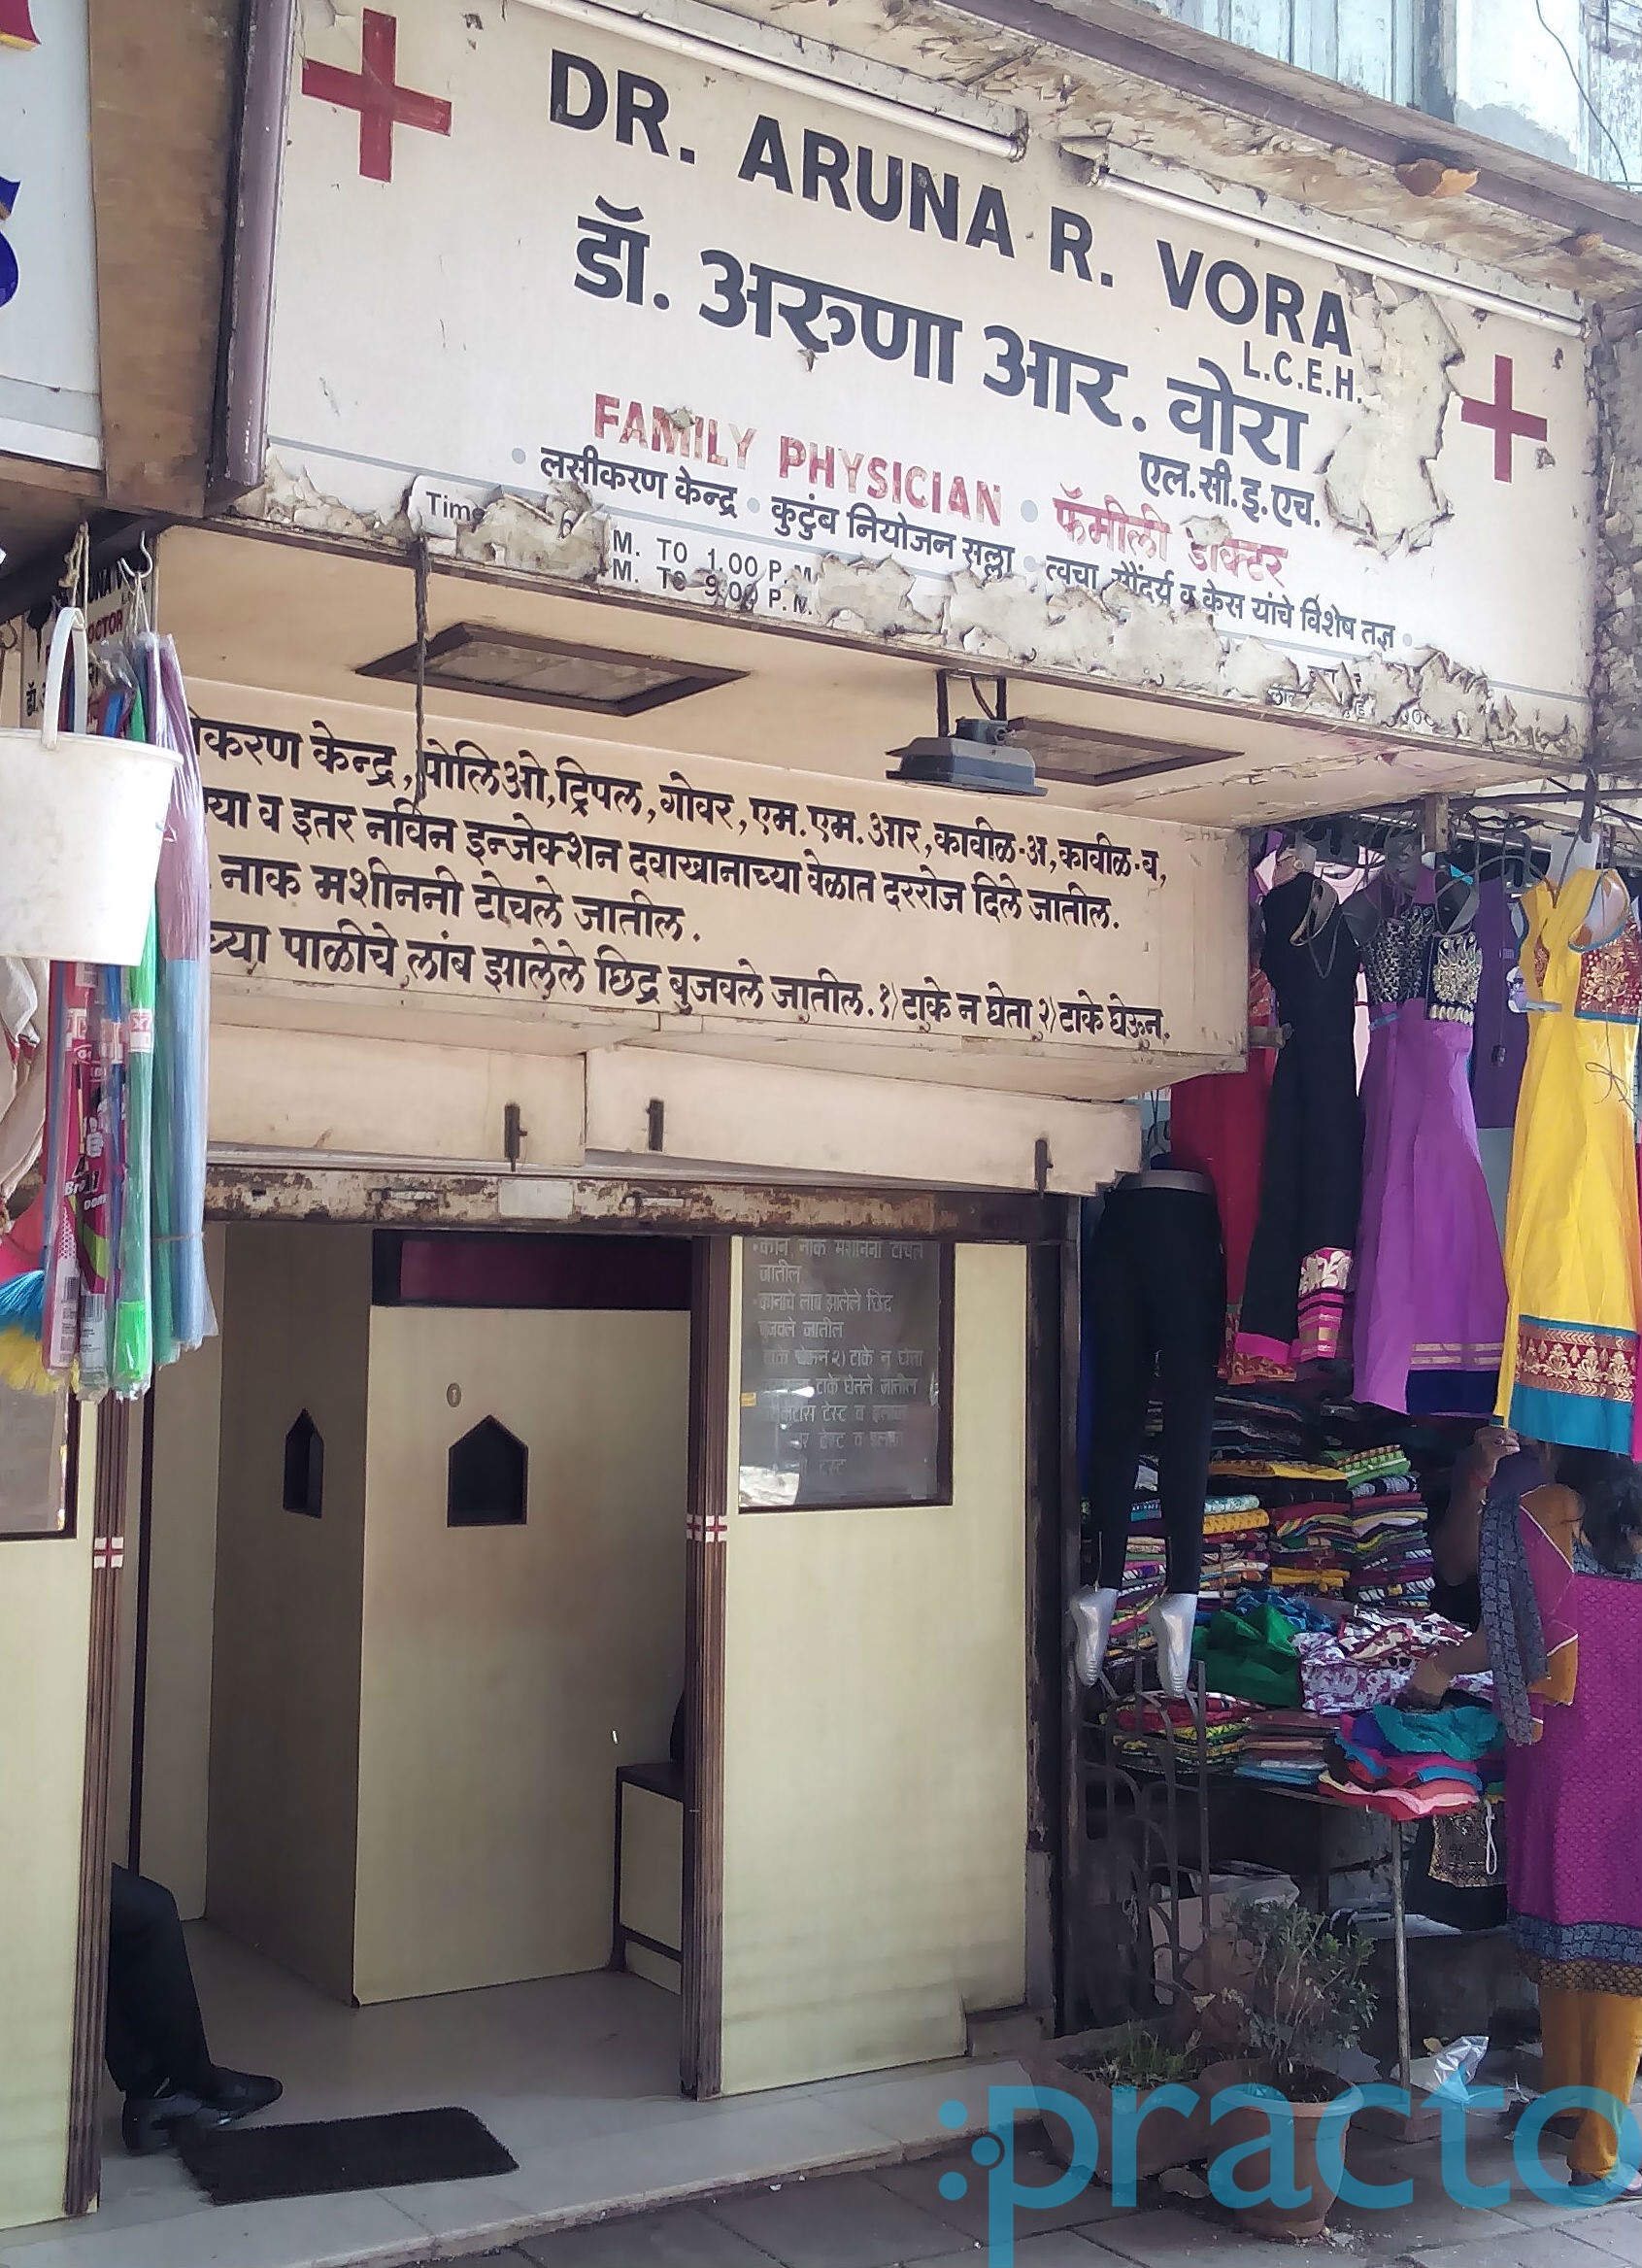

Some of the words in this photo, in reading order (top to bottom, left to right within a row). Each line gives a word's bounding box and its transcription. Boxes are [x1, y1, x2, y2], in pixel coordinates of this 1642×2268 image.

[550, 49, 695, 165] DR.
[737, 114, 1015, 259] ARUNA
[1050, 206, 1113, 288] R.
[1156, 240, 1352, 356] VORA
[574, 194, 670, 311] डॉ.
[699, 248, 962, 385] अरुणा
[983, 324, 1147, 432] आर.
[1166, 357, 1309, 471] वोरा
[1243, 340, 1363, 403] L.C.E.H.
[593, 392, 757, 470] FAMILY
[779, 435, 1001, 526] PHYSICIAN
[540, 444, 668, 500] लसीकरण
[675, 466, 738, 519] केन्द्र
[771, 493, 840, 542] कुटुंब
[847, 502, 956, 559] नियोजन
[1202, 578, 1245, 620] केस
[657, 538, 687, 563] TO
[708, 548, 758, 577] 1.00
[87, 609, 123, 644] OCTOR
[218, 854, 302, 899] नाक
[472, 869, 565, 930] टोचले
[256, 793, 285, 833] व
[290, 797, 357, 846] इतर
[881, 864, 966, 915] दररोज
[971, 870, 1022, 923] दिले
[279, 917, 399, 978] पाळीचे
[955, 992, 982, 1025] न
